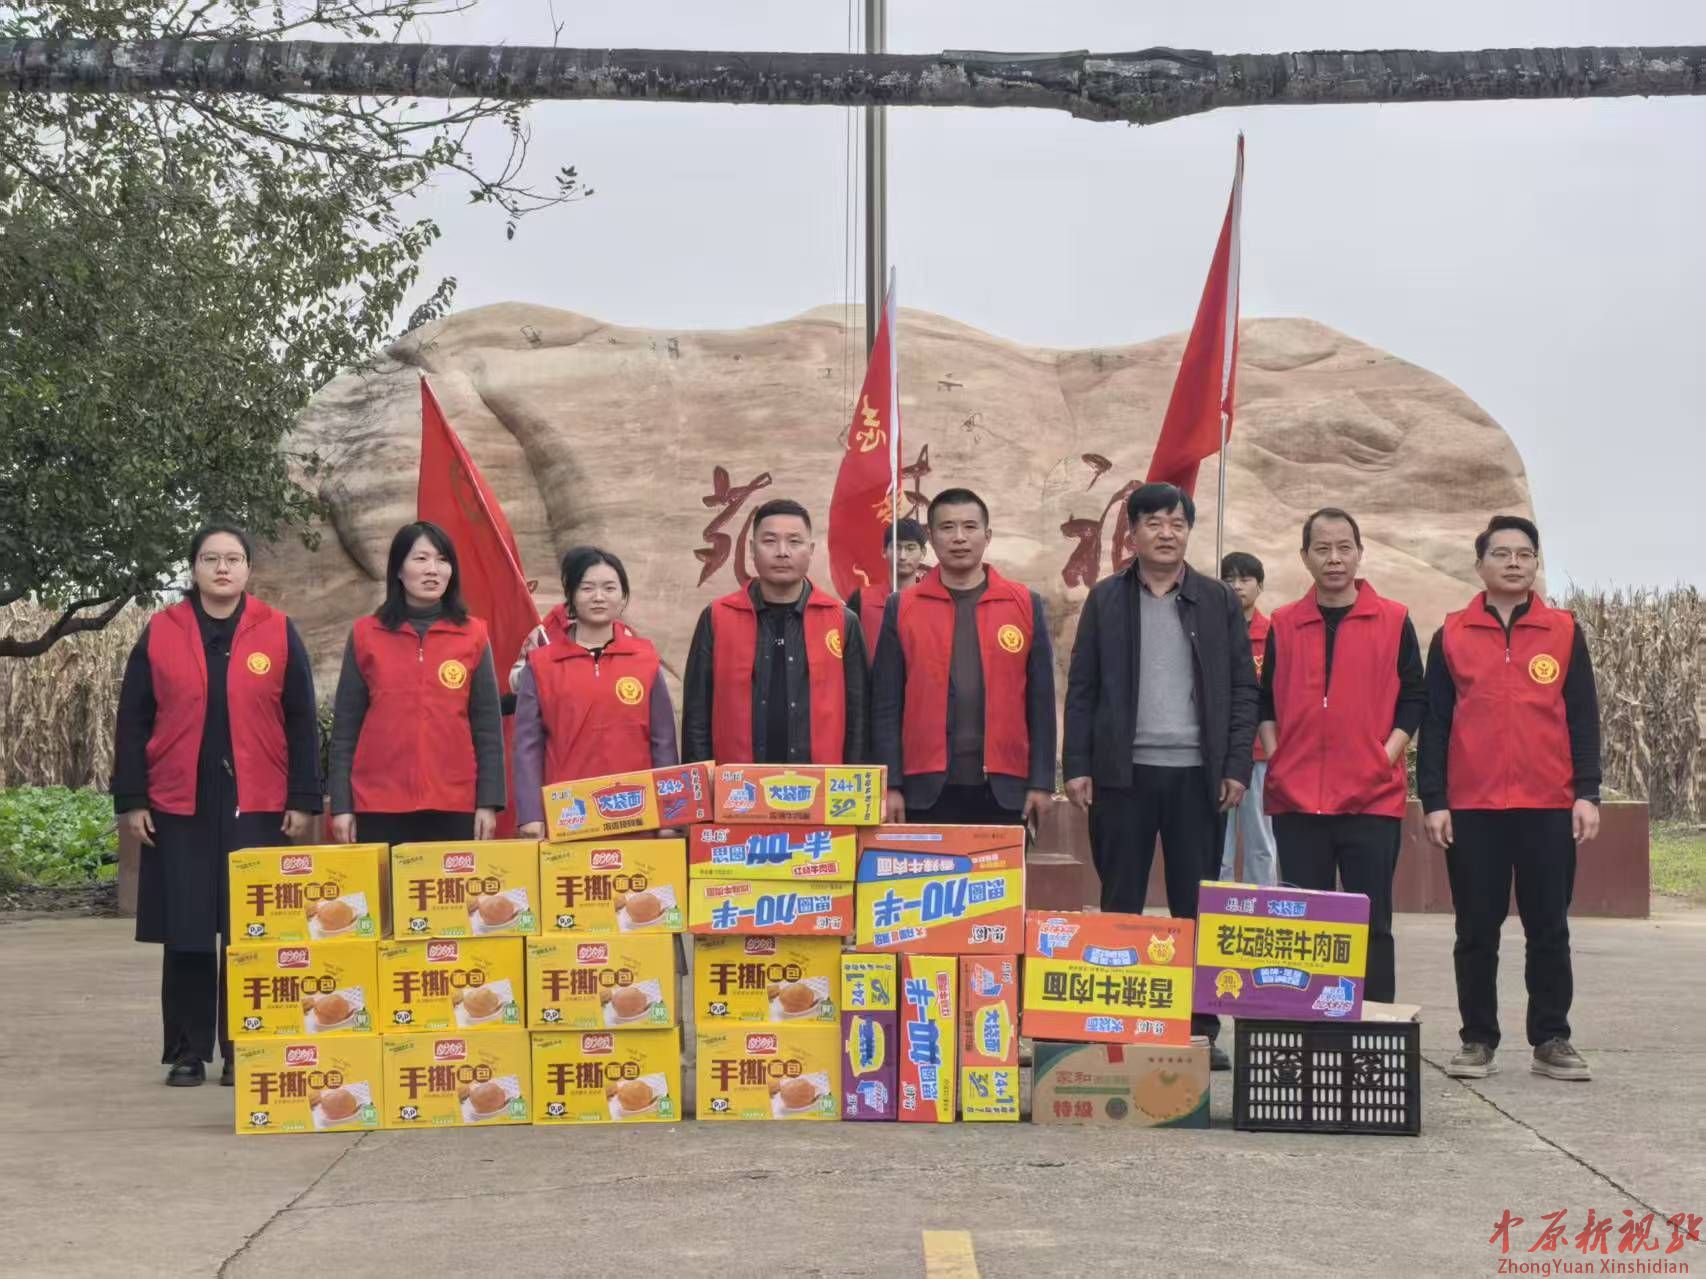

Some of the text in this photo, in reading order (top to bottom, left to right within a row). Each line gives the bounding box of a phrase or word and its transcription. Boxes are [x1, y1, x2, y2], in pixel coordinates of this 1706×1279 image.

[599, 790, 641, 811] 大袋面
[768, 785, 812, 803] 大袋面
[711, 830, 832, 866] 思圆加一半
[711, 892, 832, 930] 思圆加一半
[873, 875, 1005, 927] 思圆加一半
[1267, 900, 1307, 916] 大袋面
[1217, 925, 1352, 964] 老坛酸菜牛肉面
[1042, 972, 1174, 1009] 香辣牛肉面
[984, 1010, 1001, 1052] 大袋面
